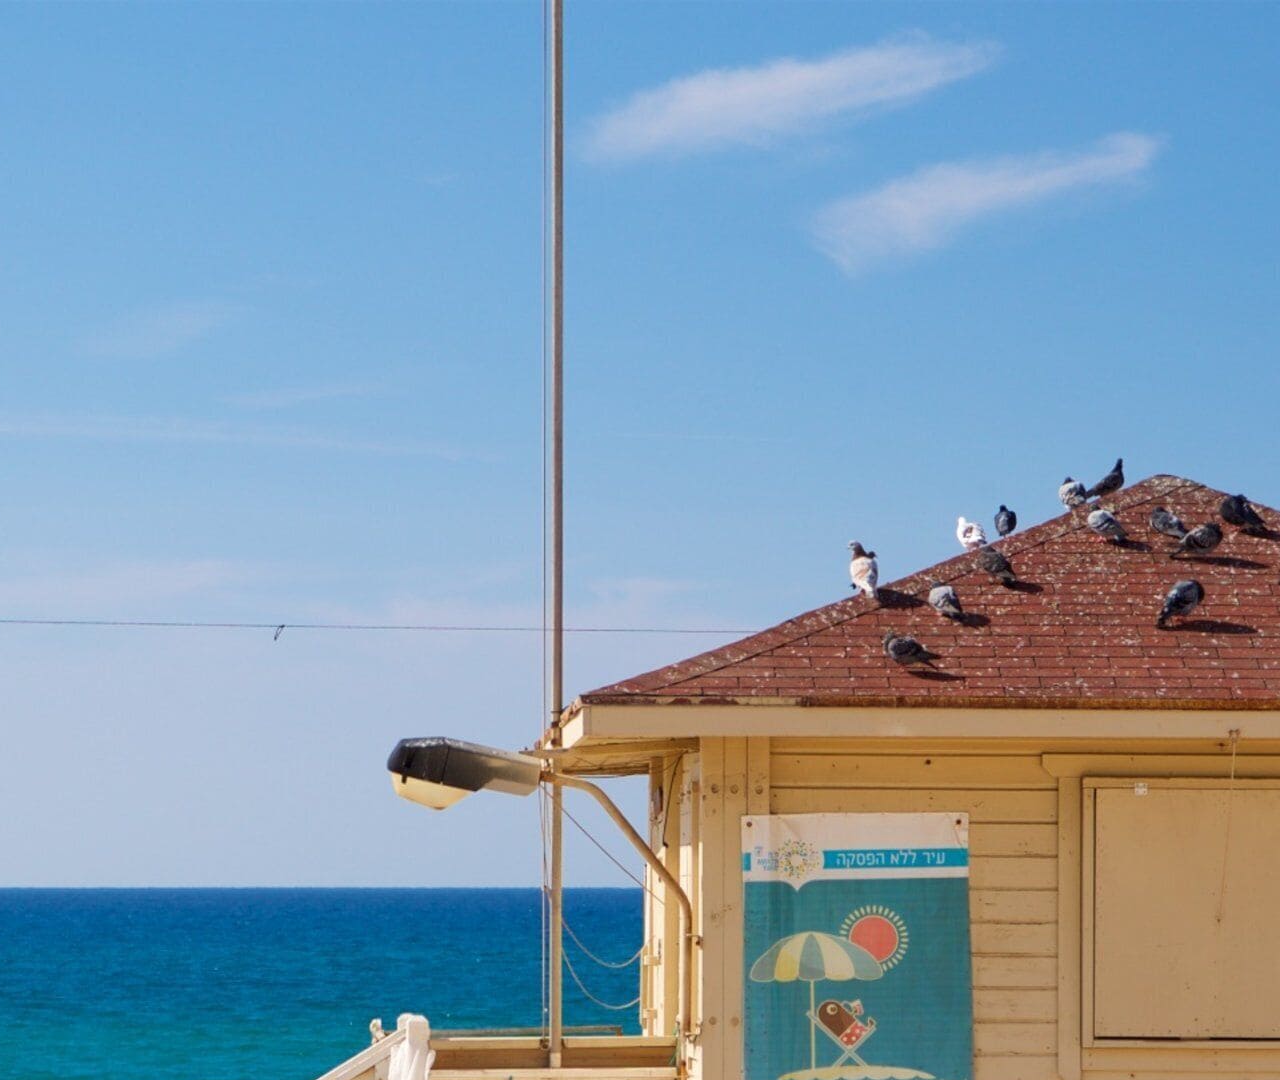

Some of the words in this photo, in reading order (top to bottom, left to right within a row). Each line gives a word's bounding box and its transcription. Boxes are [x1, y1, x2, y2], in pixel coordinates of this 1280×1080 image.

[836, 852, 885, 868] הפסקה
[890, 851, 917, 865] ללא
[923, 851, 946, 865] עיר
